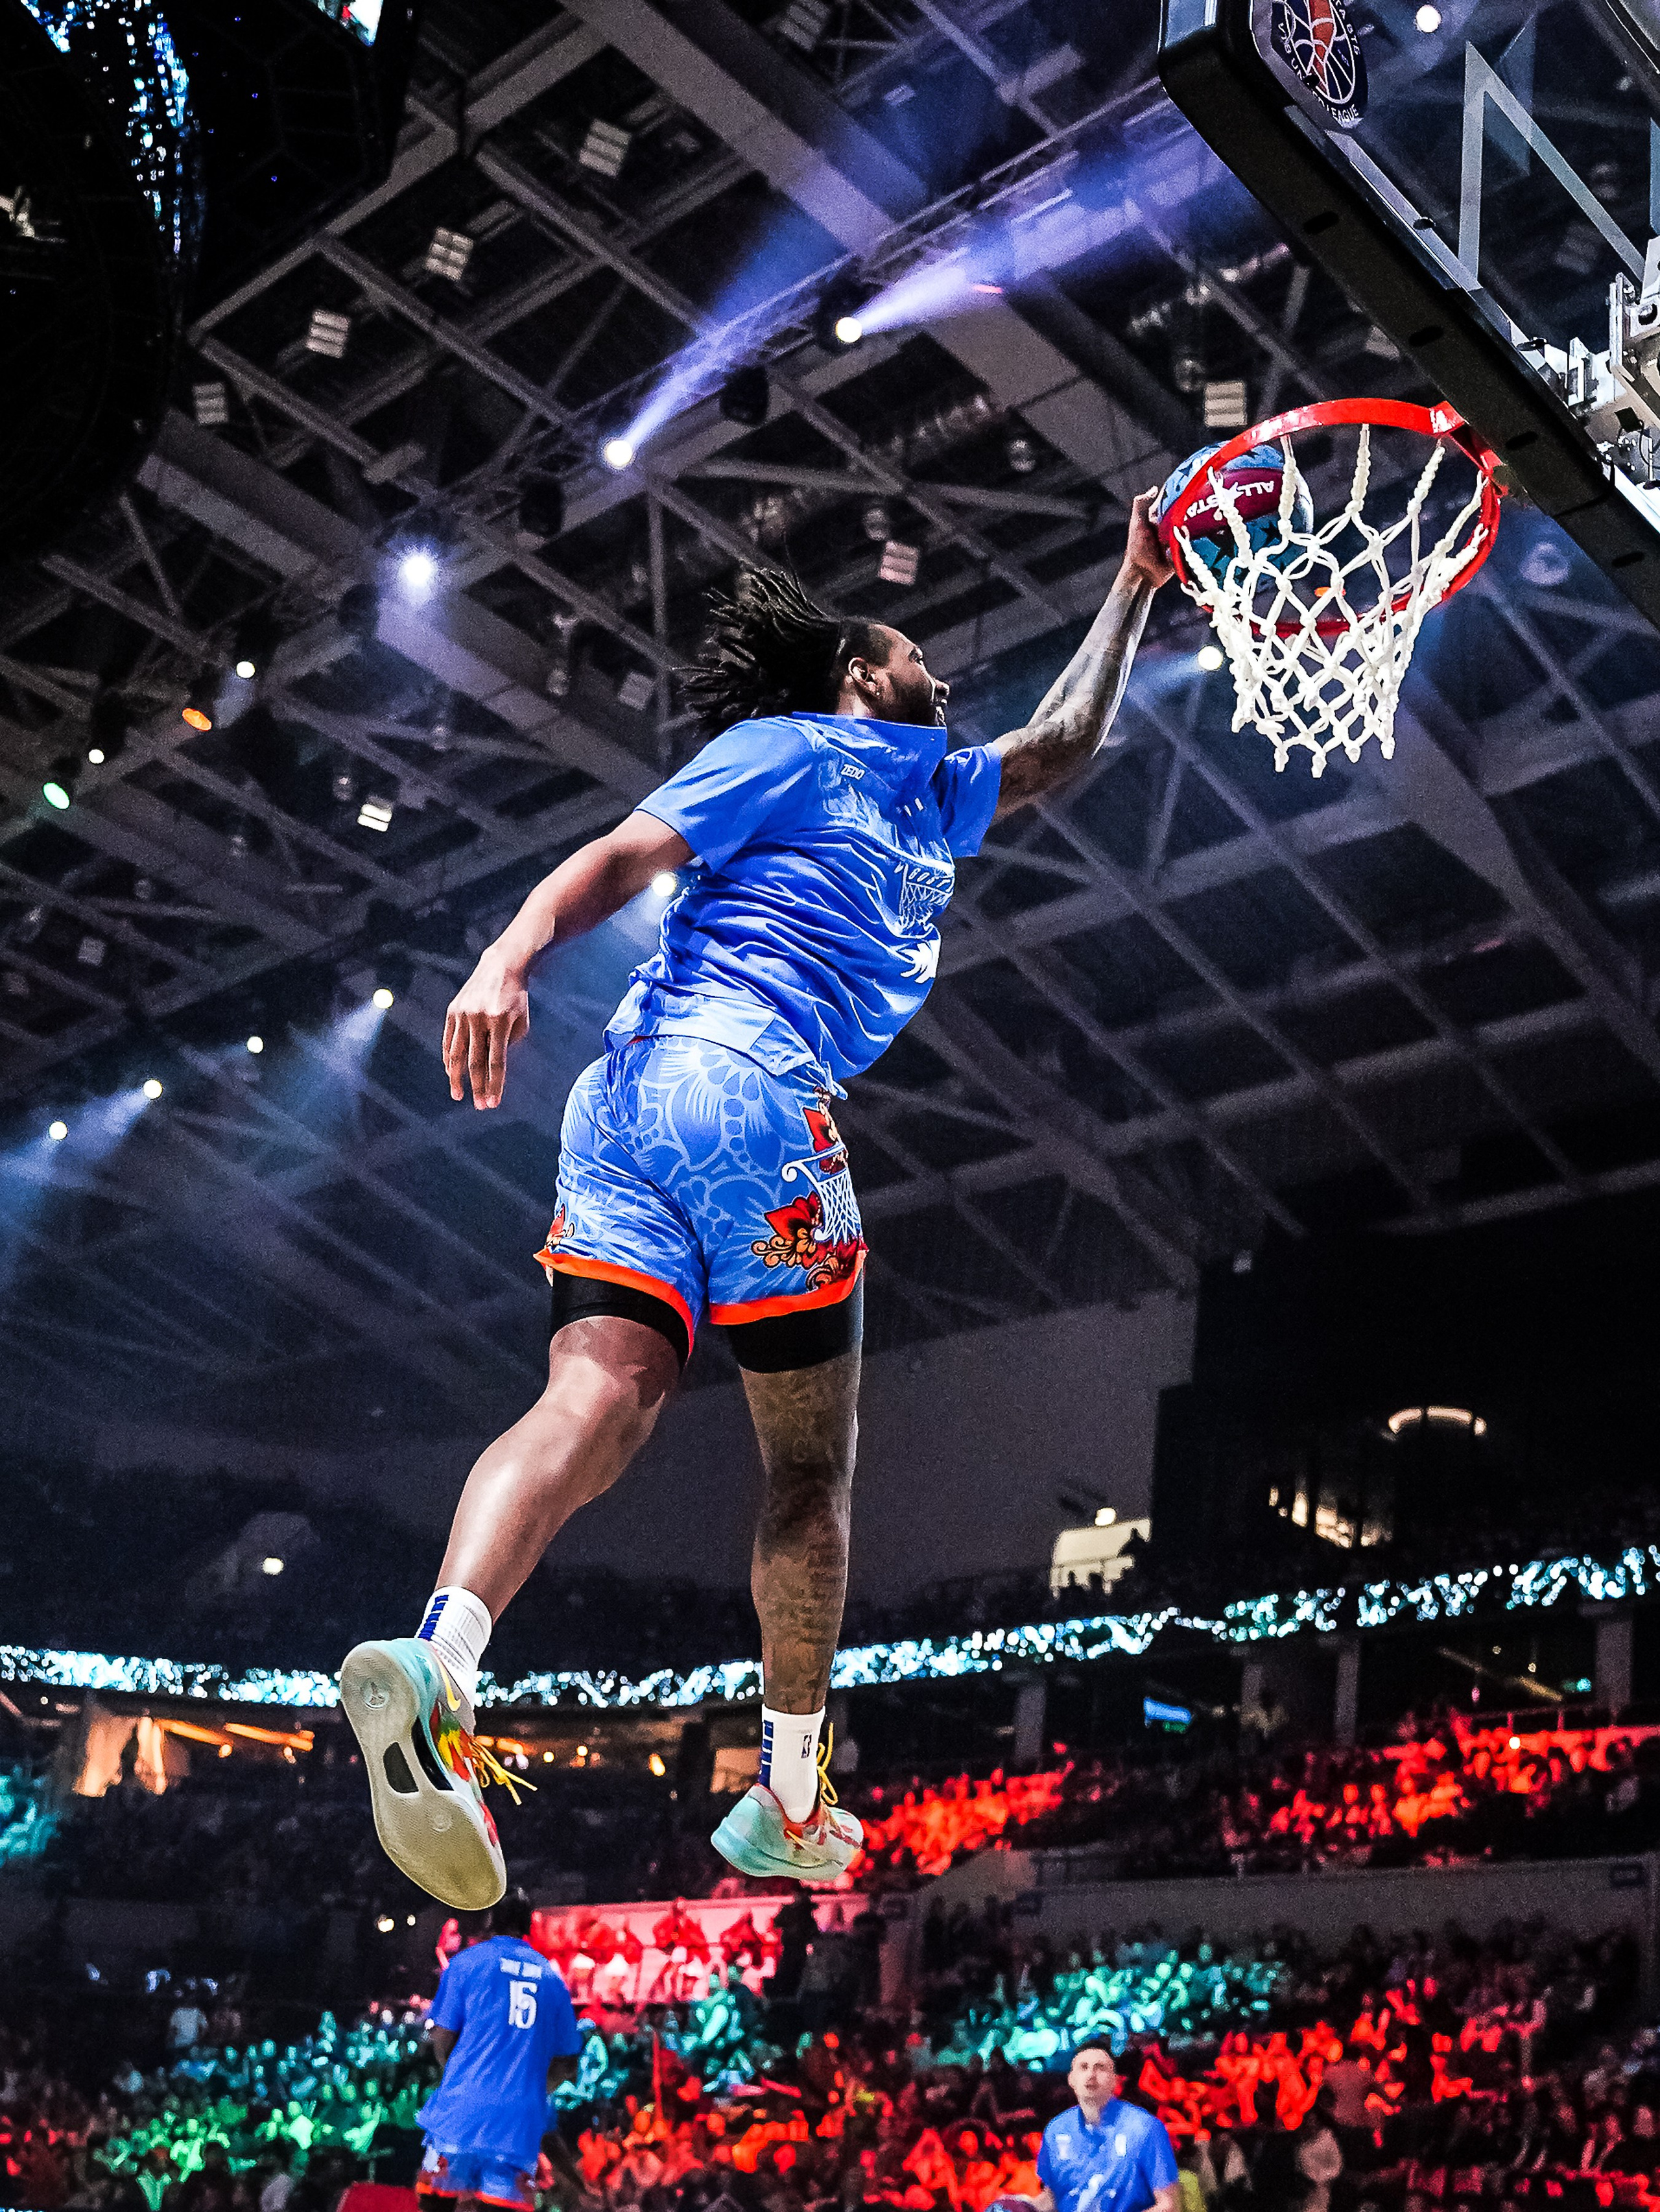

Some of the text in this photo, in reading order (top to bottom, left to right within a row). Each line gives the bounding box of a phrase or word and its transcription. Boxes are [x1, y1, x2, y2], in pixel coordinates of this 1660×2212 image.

[1183, 481, 1274, 521] ALL STA
[508, 1979, 538, 2029] 15
